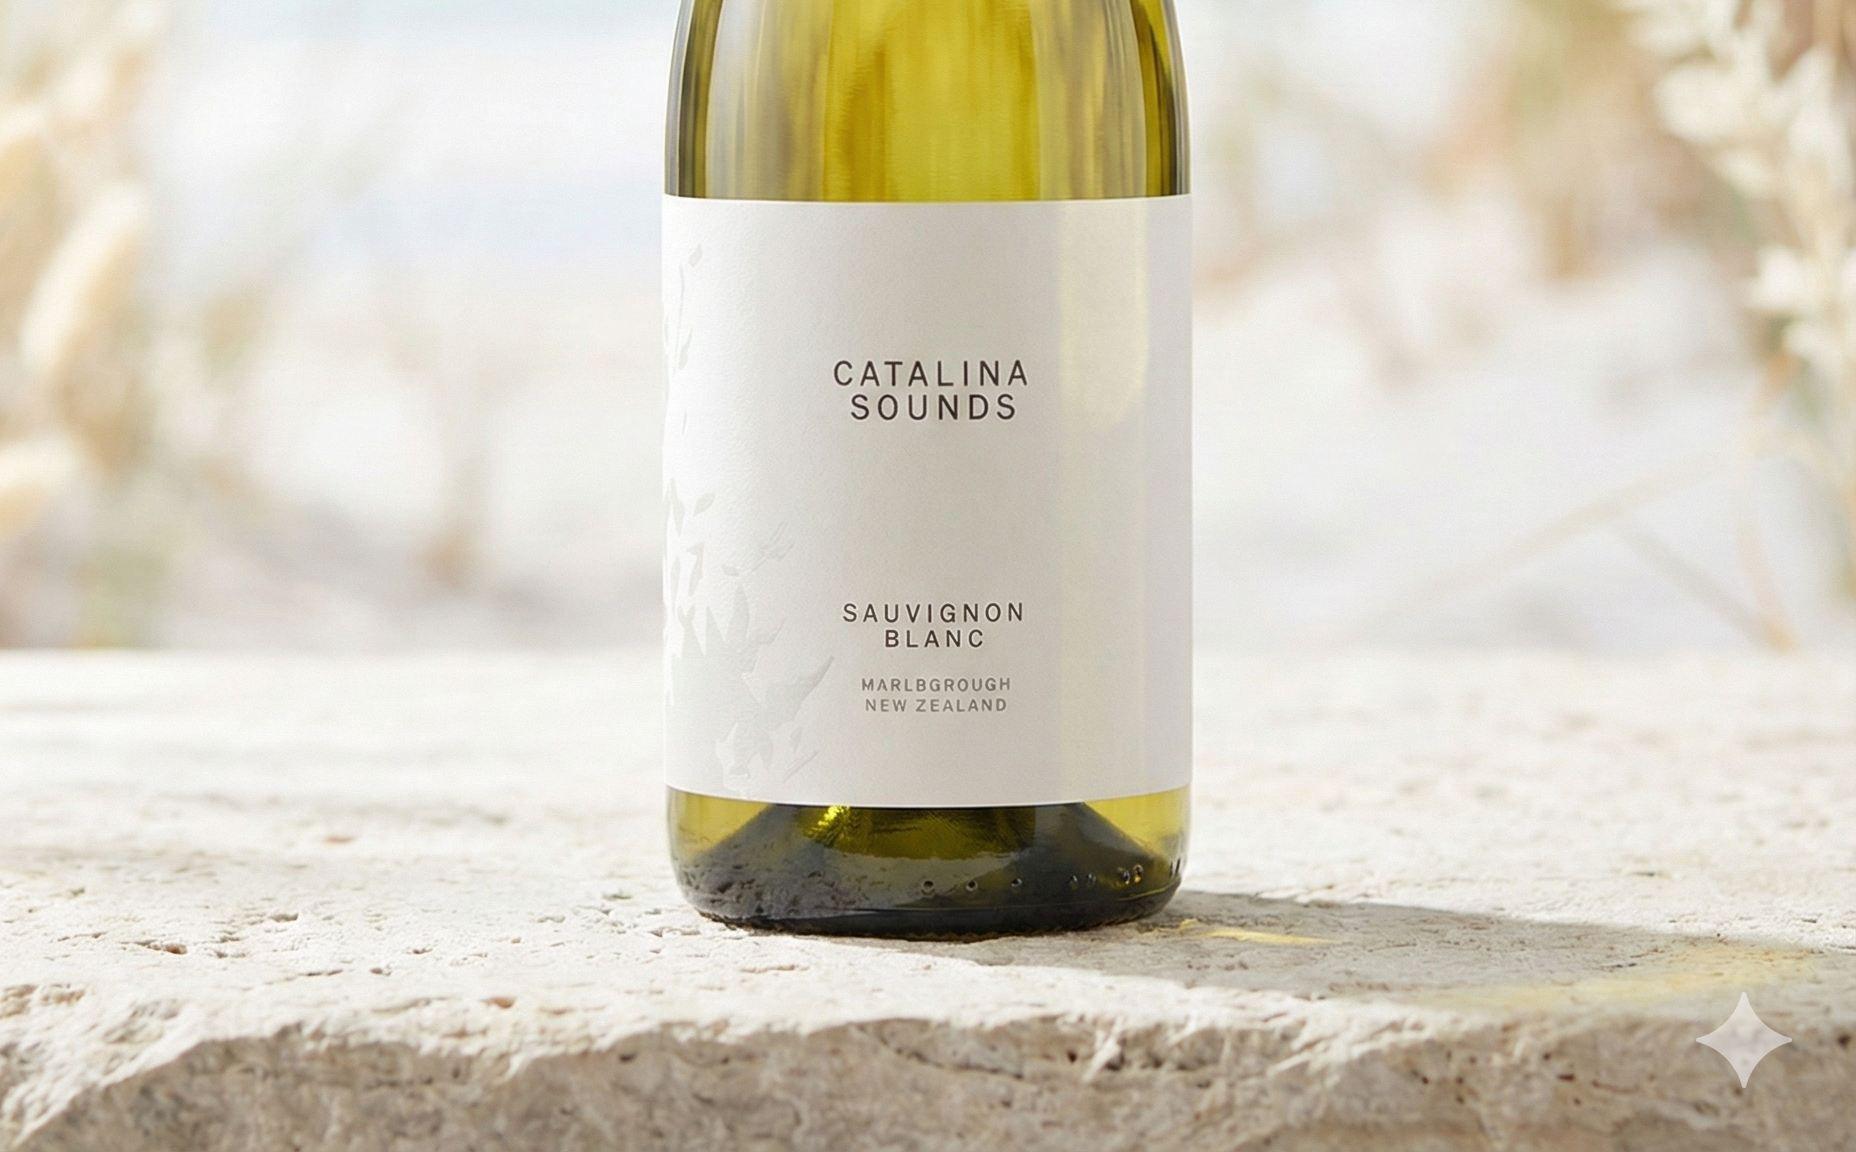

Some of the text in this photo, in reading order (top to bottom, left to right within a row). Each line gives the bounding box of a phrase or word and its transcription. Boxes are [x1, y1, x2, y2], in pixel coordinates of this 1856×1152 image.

[833, 359, 1028, 387] CATALINA
[850, 393, 1016, 421] SOUNDS
[842, 602, 1024, 623] SAUVIGNON
[884, 628, 984, 648] BLANC
[864, 698, 1008, 713] NEW ZEALAND
